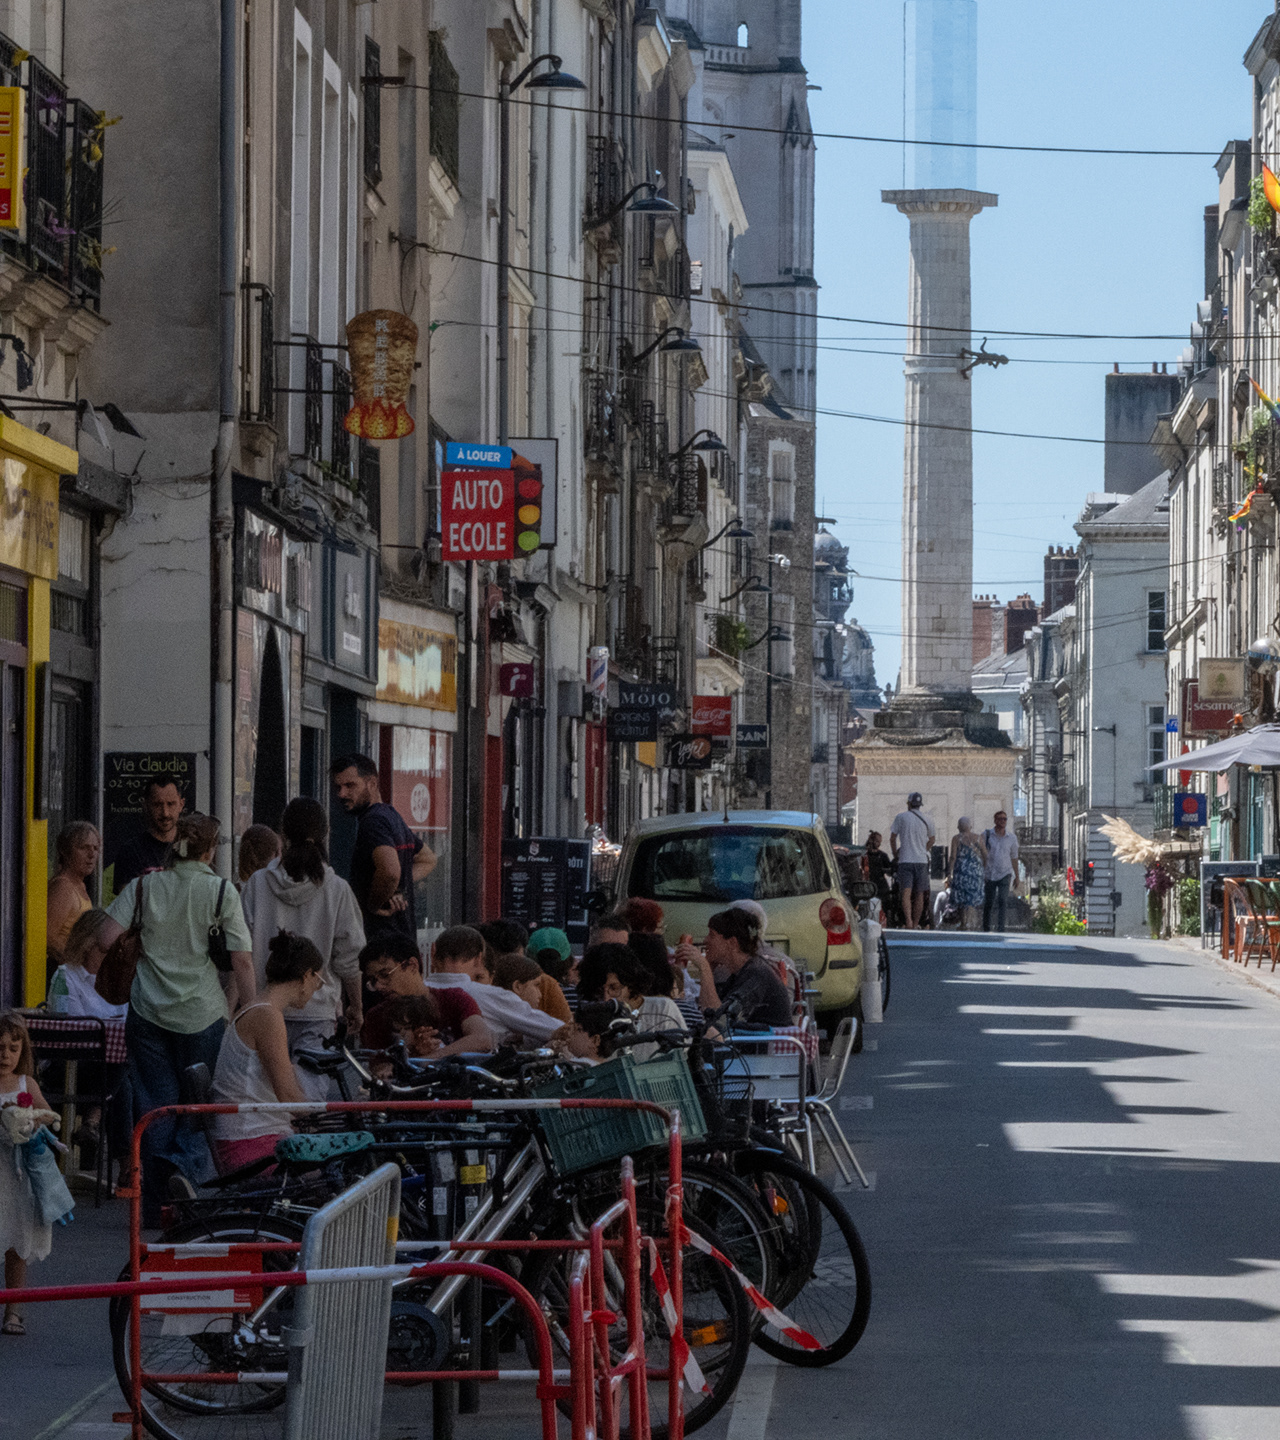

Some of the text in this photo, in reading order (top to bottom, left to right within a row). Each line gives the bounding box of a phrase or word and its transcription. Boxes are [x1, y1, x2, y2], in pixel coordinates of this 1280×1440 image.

[467, 450, 501, 462] LOUER
[451, 479, 504, 510] AUTO
[450, 522, 506, 553] ECOLE
[621, 692, 671, 706] MOJO
[737, 731, 767, 742] SAIN
[113, 755, 188, 772] Via Claudia
